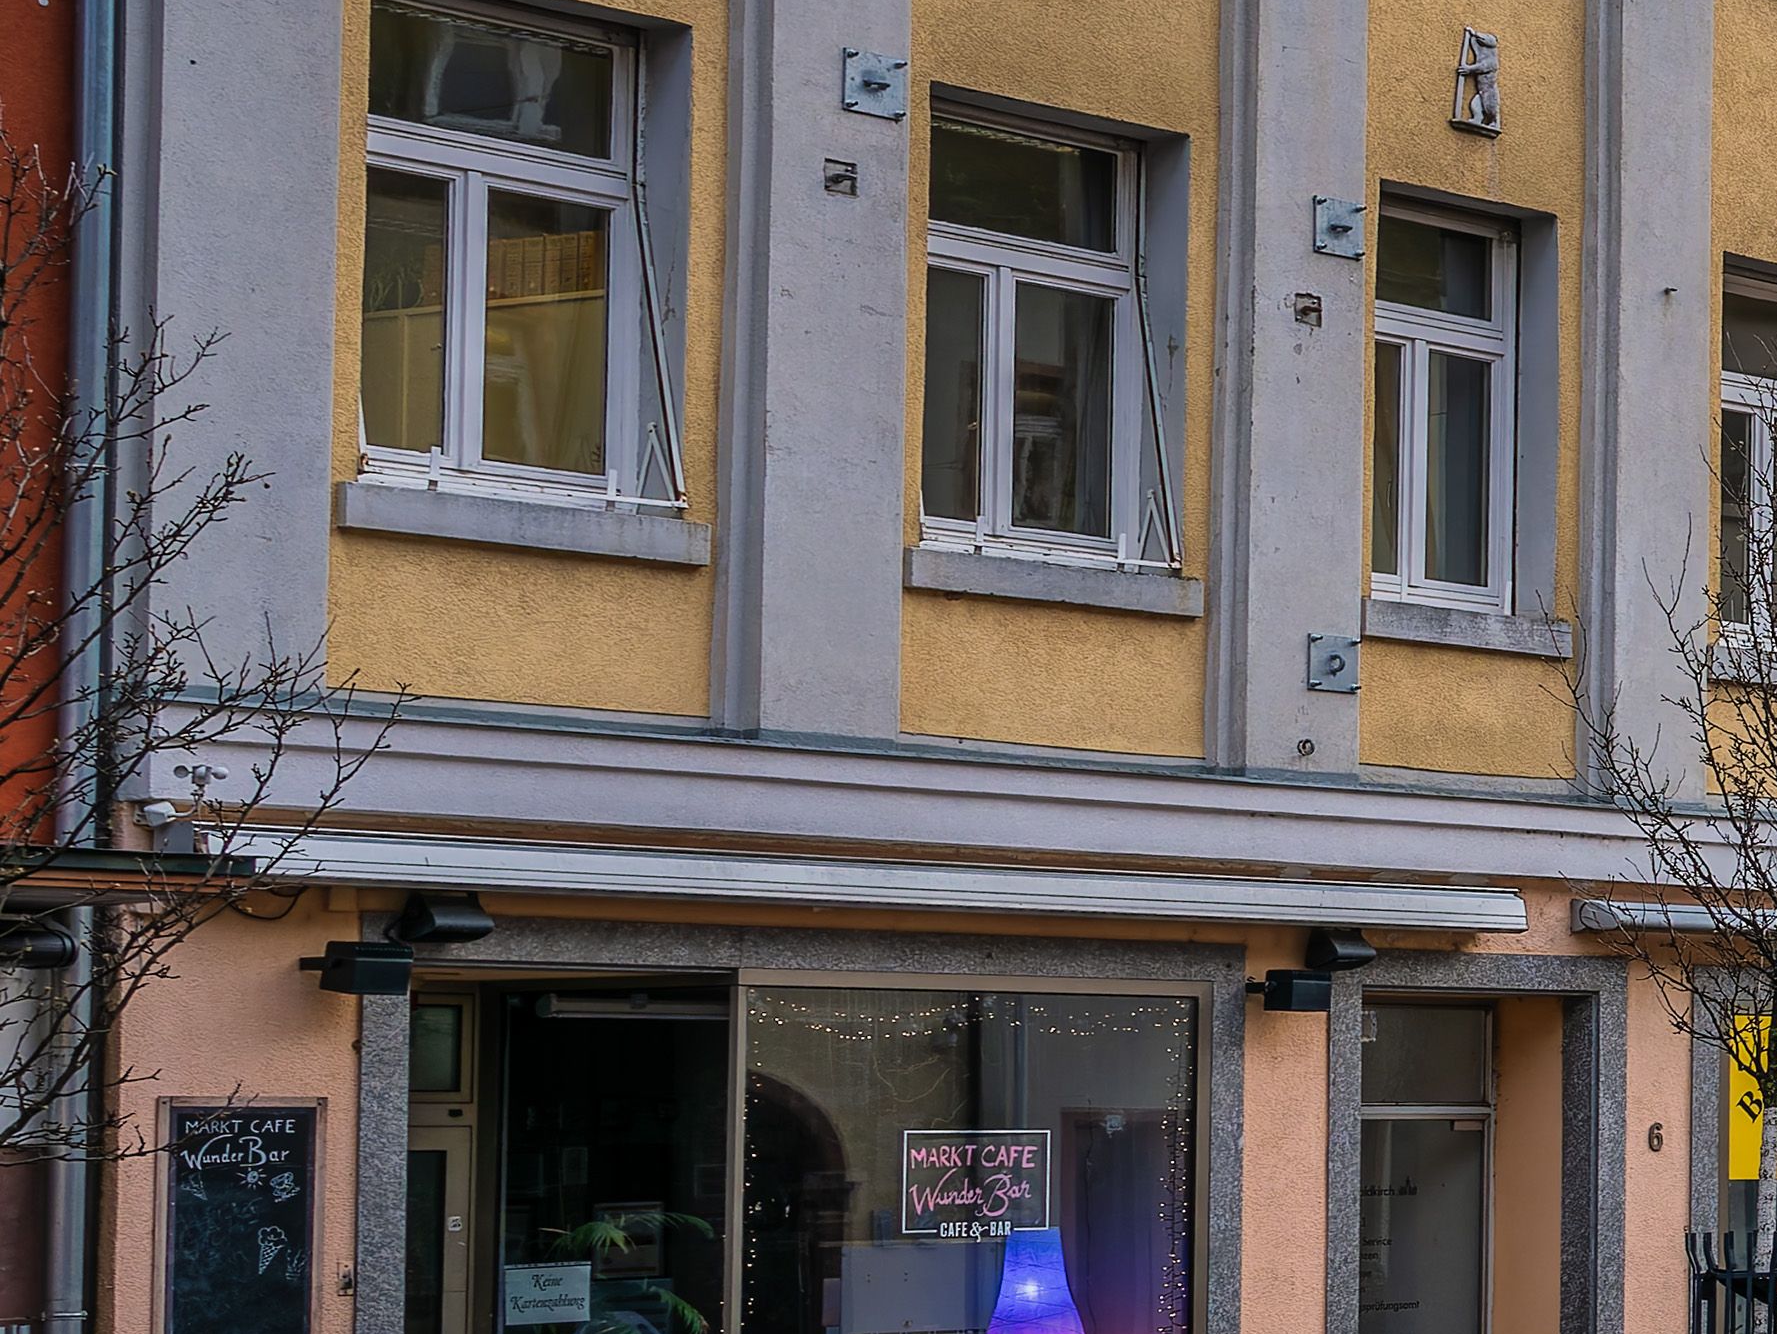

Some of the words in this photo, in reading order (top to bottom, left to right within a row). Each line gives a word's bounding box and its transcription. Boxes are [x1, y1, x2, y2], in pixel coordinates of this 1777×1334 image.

[185, 1120, 244, 1134] MARKT
[250, 1119, 296, 1134] CAFE
[1648, 1122, 1664, 1153] 6
[910, 1145, 977, 1169] MARKT
[981, 1145, 1038, 1168] CAFE
[940, 1222, 967, 1237] CAFE
[969, 1221, 988, 1242] &
[990, 1221, 1012, 1236] BAR
[532, 1273, 563, 1291] Keine
[510, 1294, 585, 1313] Kartenzahlung
